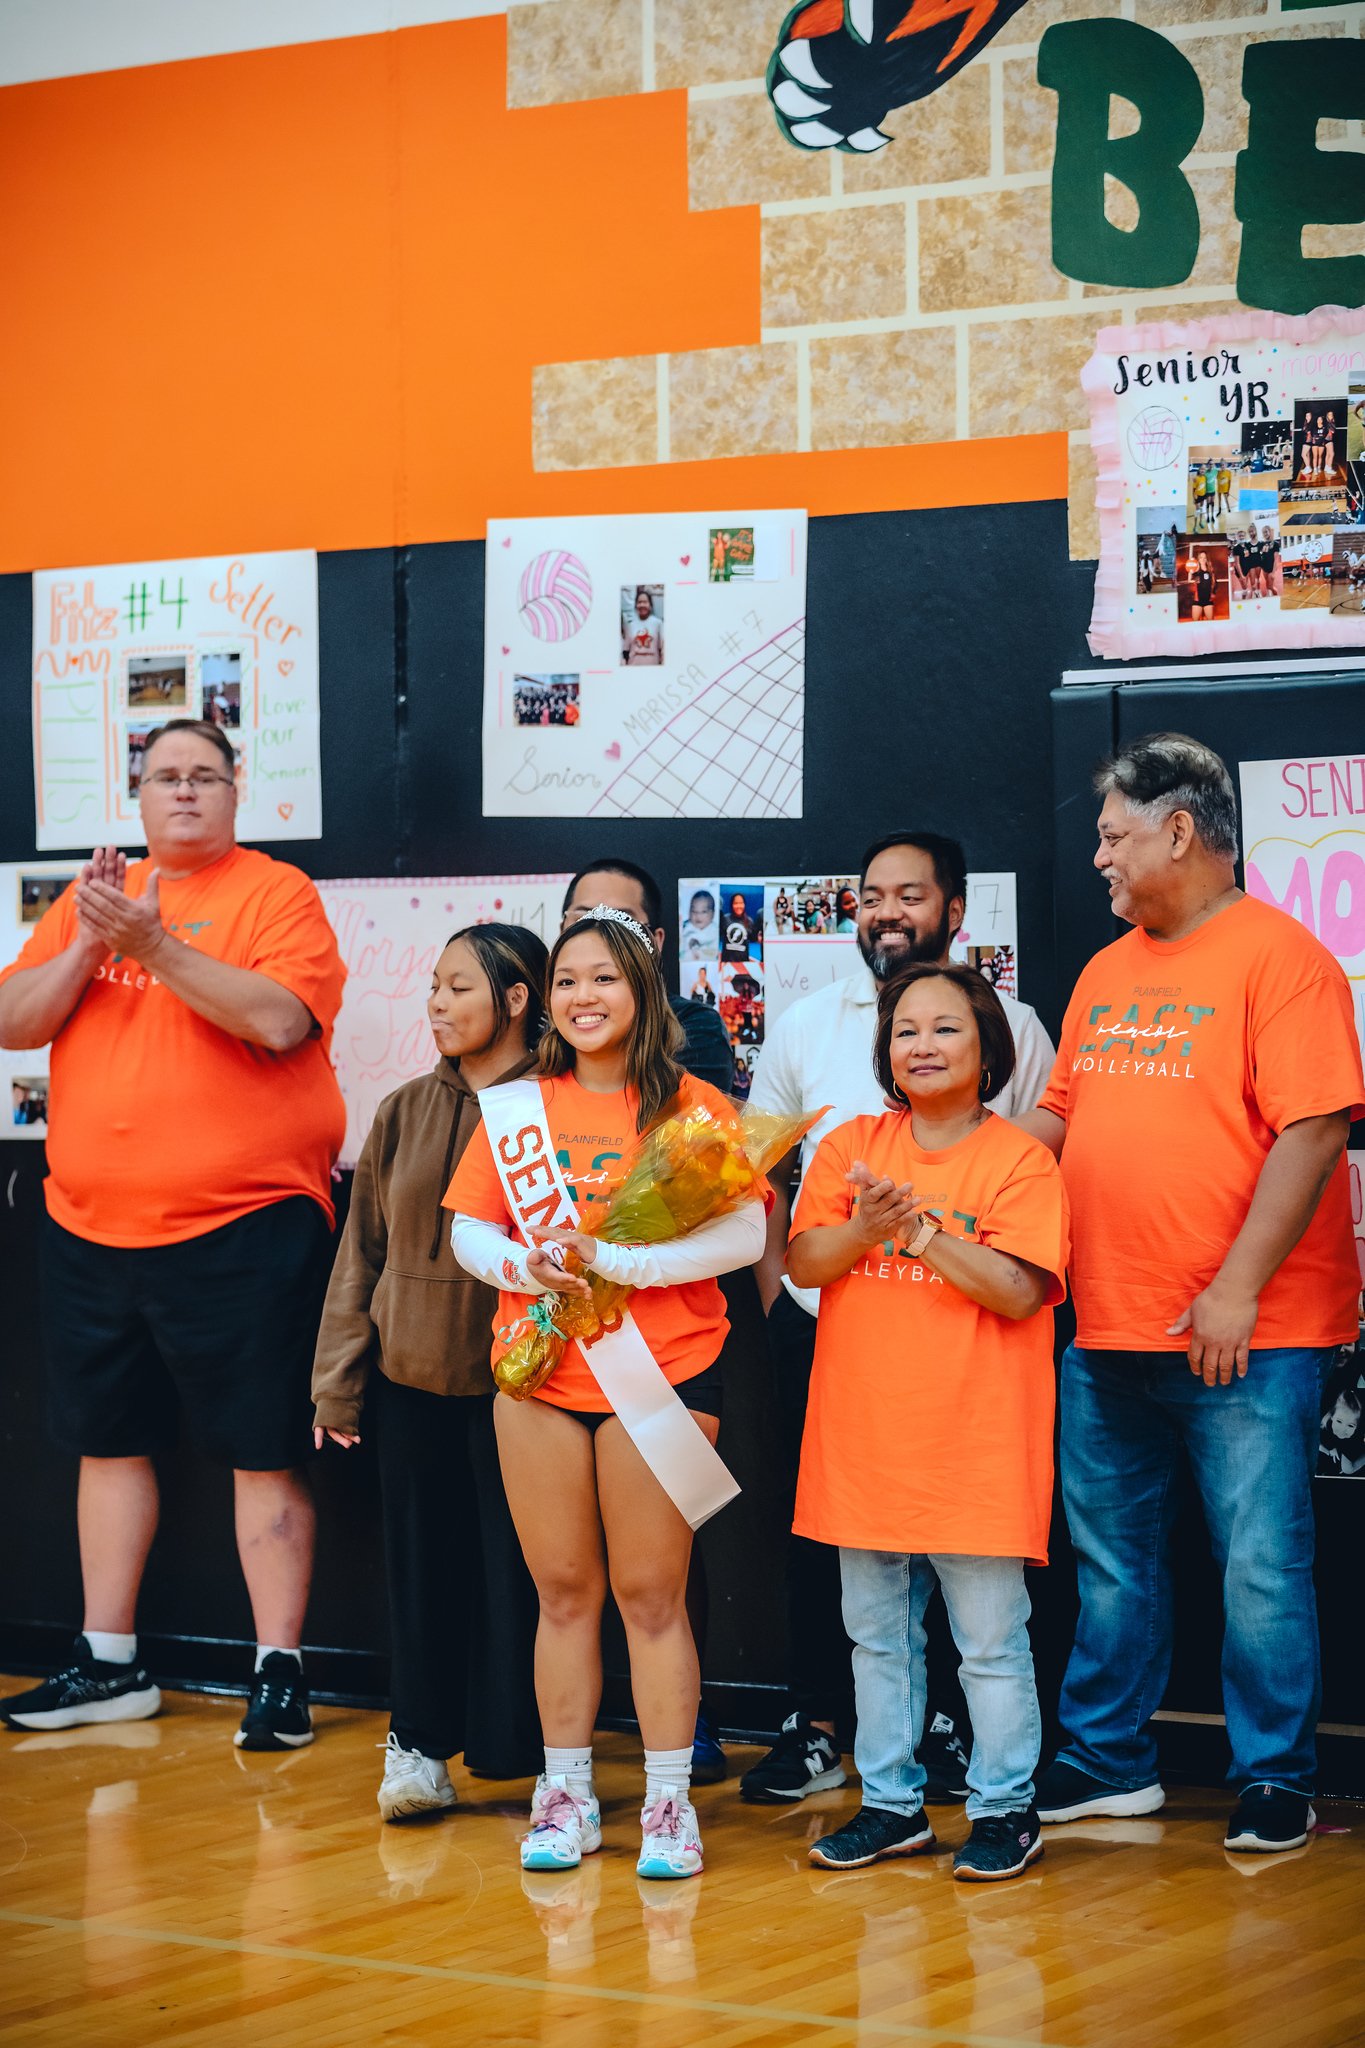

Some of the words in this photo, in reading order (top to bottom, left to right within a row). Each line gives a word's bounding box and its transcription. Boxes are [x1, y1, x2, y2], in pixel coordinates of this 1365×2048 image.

[1113, 350, 1241, 395] Senior
[123, 577, 189, 632] #4
[622, 663, 708, 746] MARISSA
[503, 745, 602, 795] Senior
[327, 896, 437, 999] Morga
[775, 963, 809, 991] We
[1132, 986, 1182, 997] PLAINFIELD
[1073, 1057, 1195, 1079] VOLLEYBALL
[557, 1132, 624, 1146] PLAINFIELD
